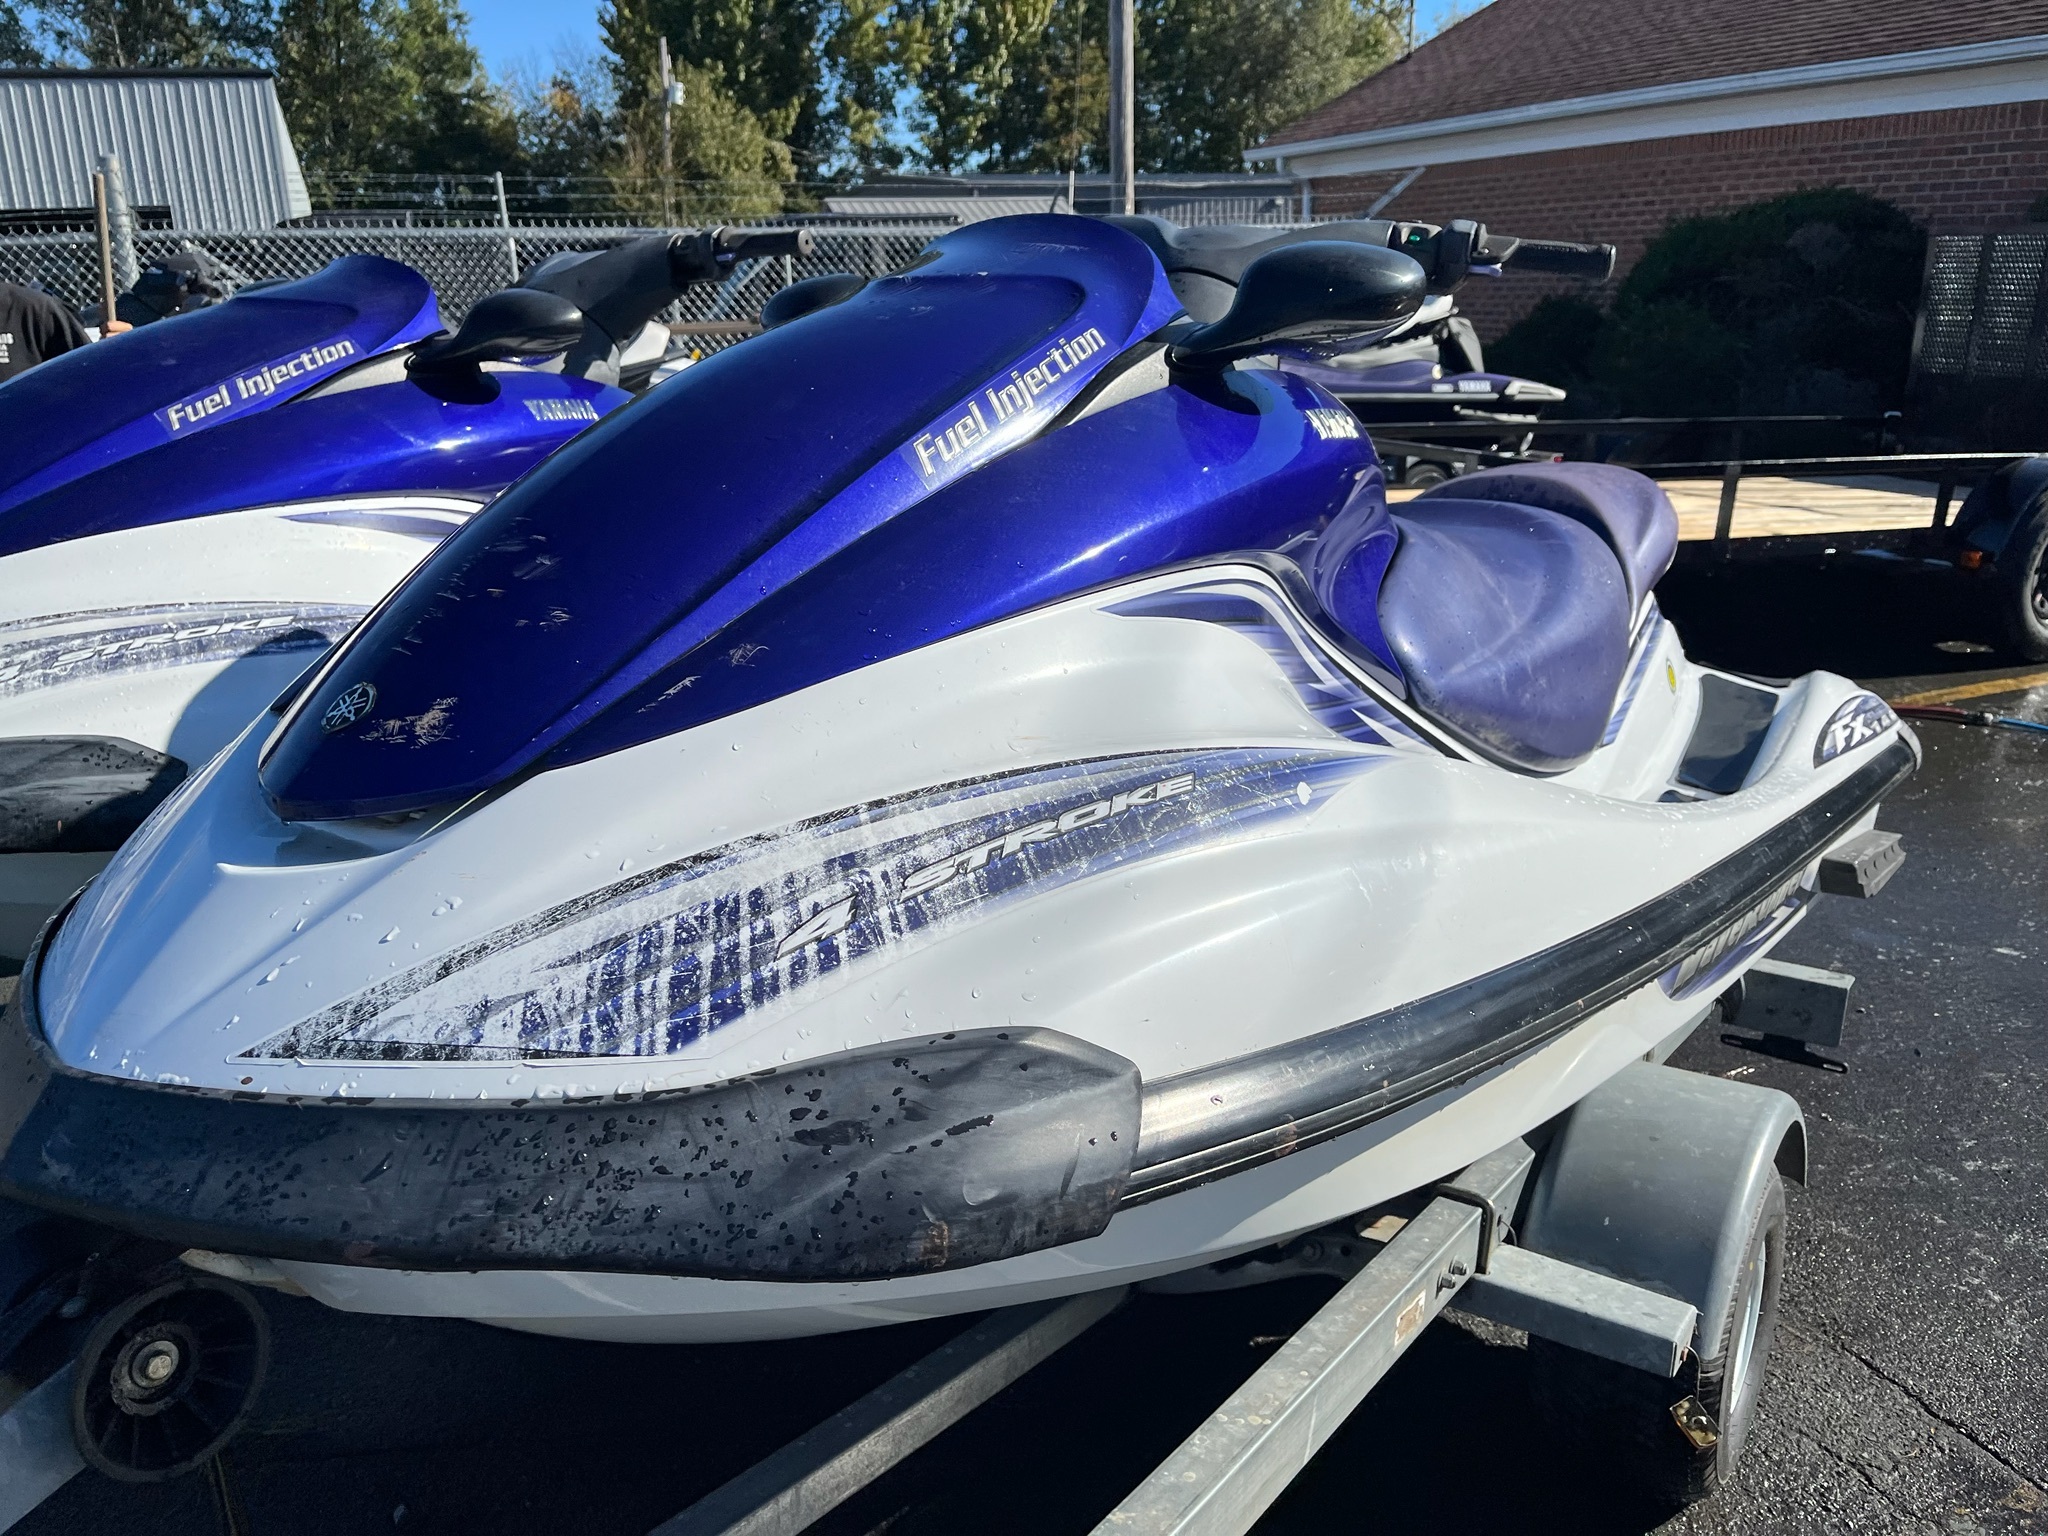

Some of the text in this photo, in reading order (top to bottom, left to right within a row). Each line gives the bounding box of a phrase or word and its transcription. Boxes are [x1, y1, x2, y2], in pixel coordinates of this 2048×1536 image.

[167, 339, 355, 431] Fuel Injection
[522, 398, 600, 421] YAMAHA
[913, 327, 1107, 477] Fuel Injection
[50, 613, 298, 669] STROKE
[898, 772, 1196, 904] STROKE
